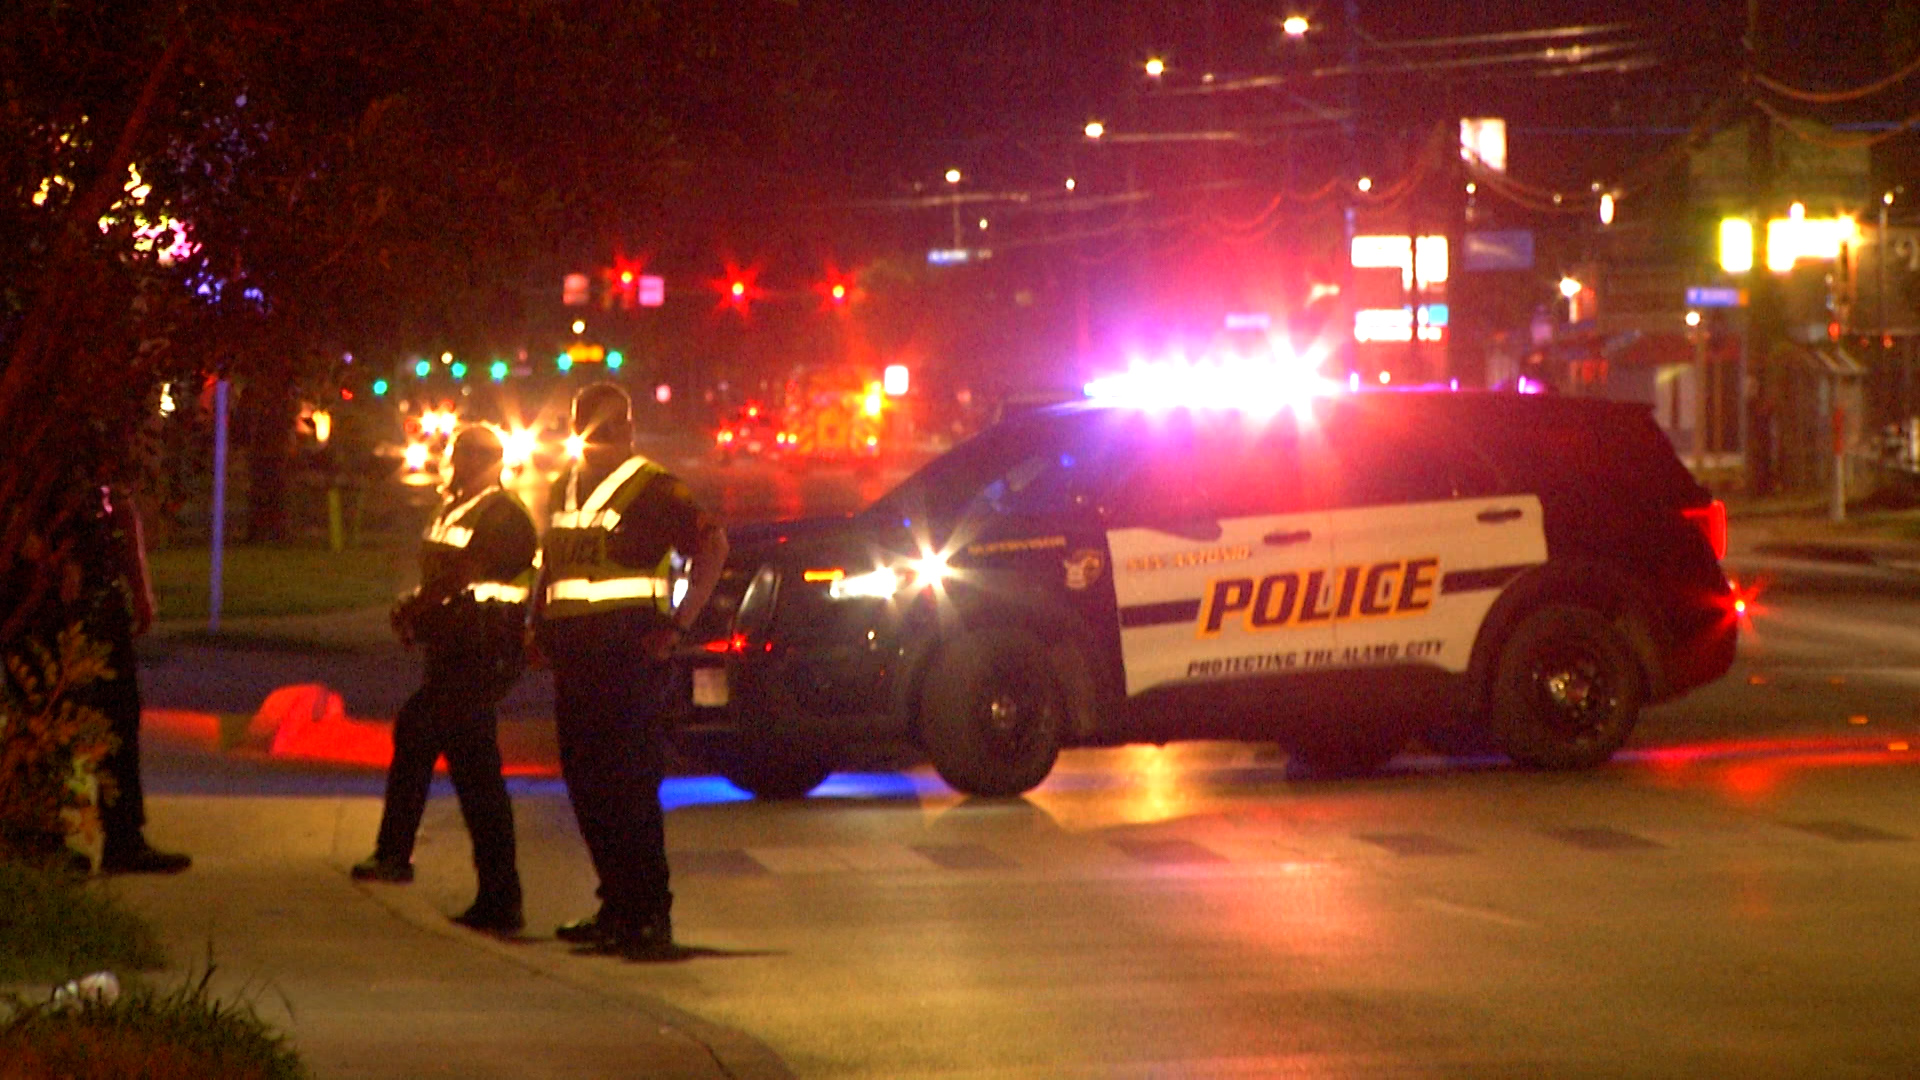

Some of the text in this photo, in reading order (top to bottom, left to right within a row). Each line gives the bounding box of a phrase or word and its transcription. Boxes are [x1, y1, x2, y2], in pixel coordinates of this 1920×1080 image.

[1198, 556, 1440, 638] POLICE
[1187, 639, 1446, 679] PROTECTING THE ALAMO CITY
